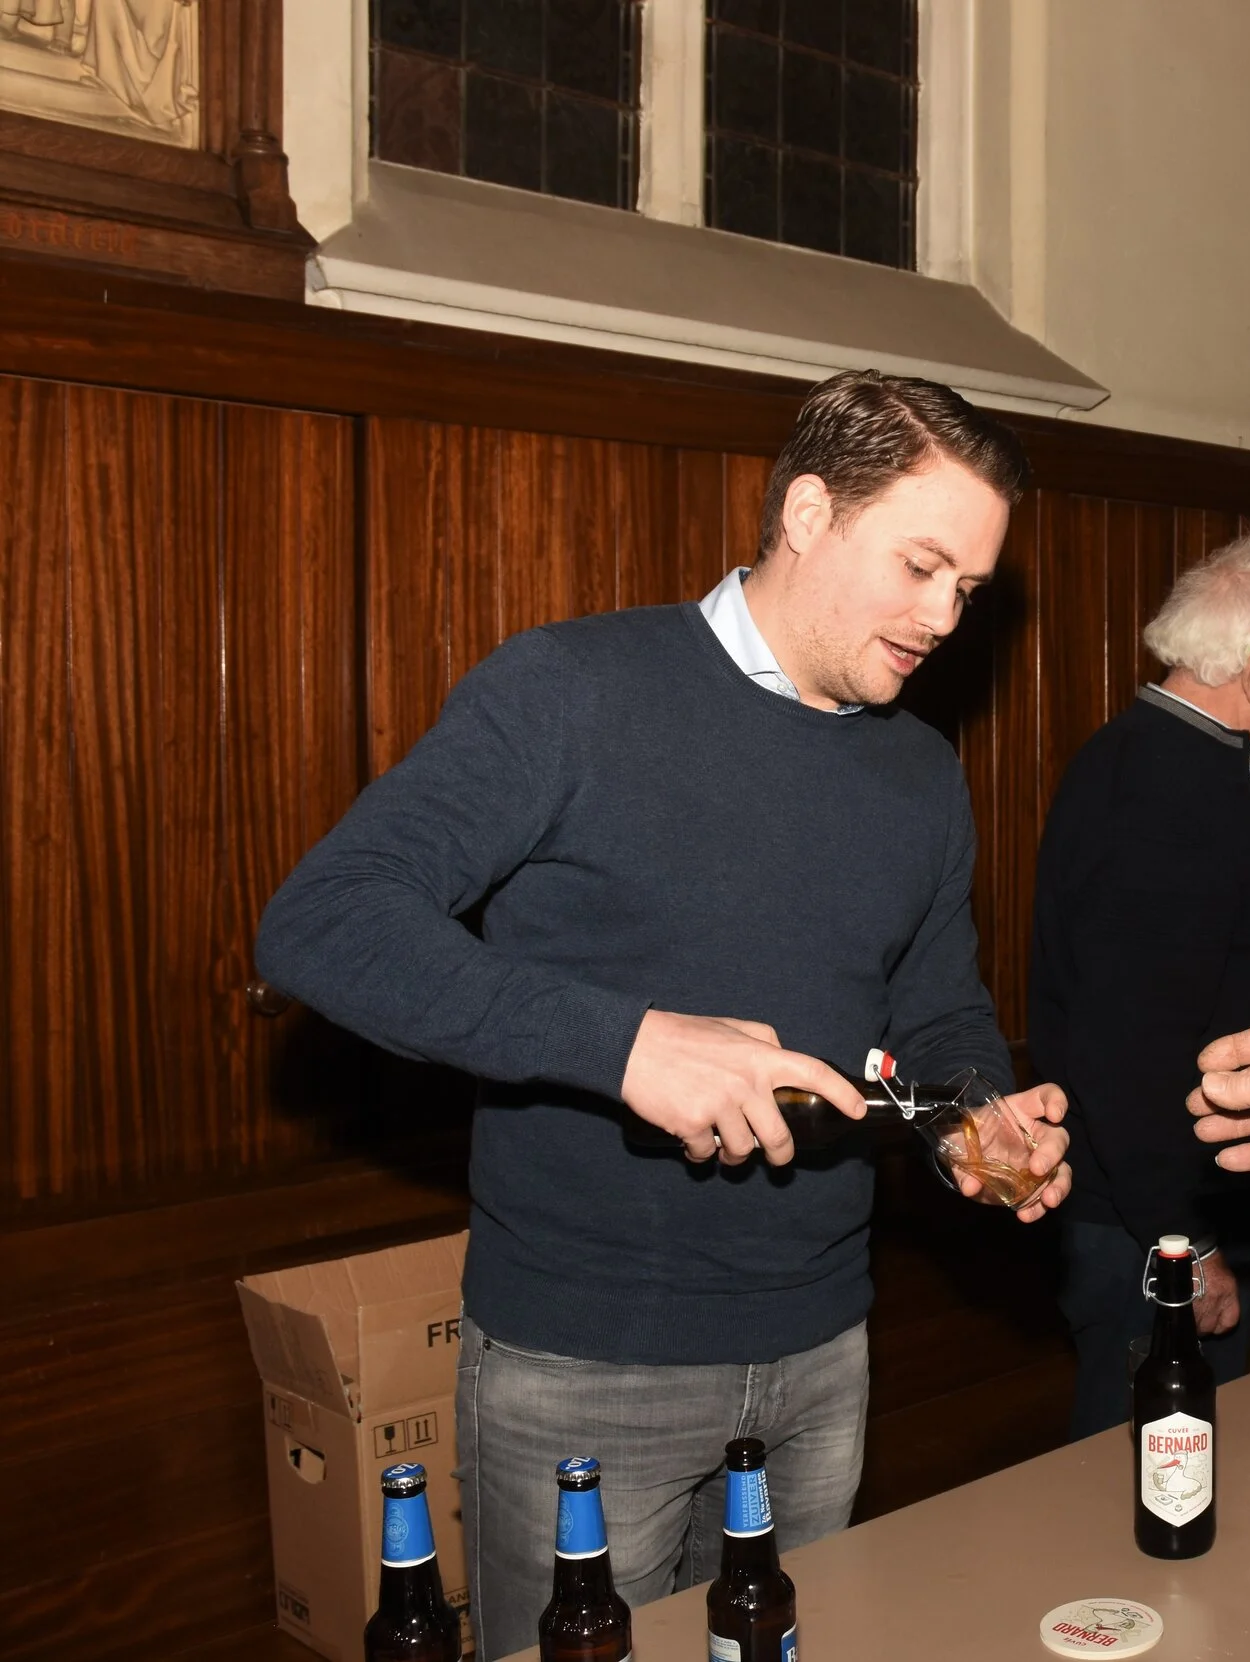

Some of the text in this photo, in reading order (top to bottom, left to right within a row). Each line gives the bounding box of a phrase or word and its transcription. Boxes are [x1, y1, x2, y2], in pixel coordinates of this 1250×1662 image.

[1148, 1432, 1208, 1455] BERNARD
[749, 1475, 760, 1524] ZUIVER
[761, 1470, 772, 1521] Bavaria
[1052, 1622, 1118, 1647] BERNARD
